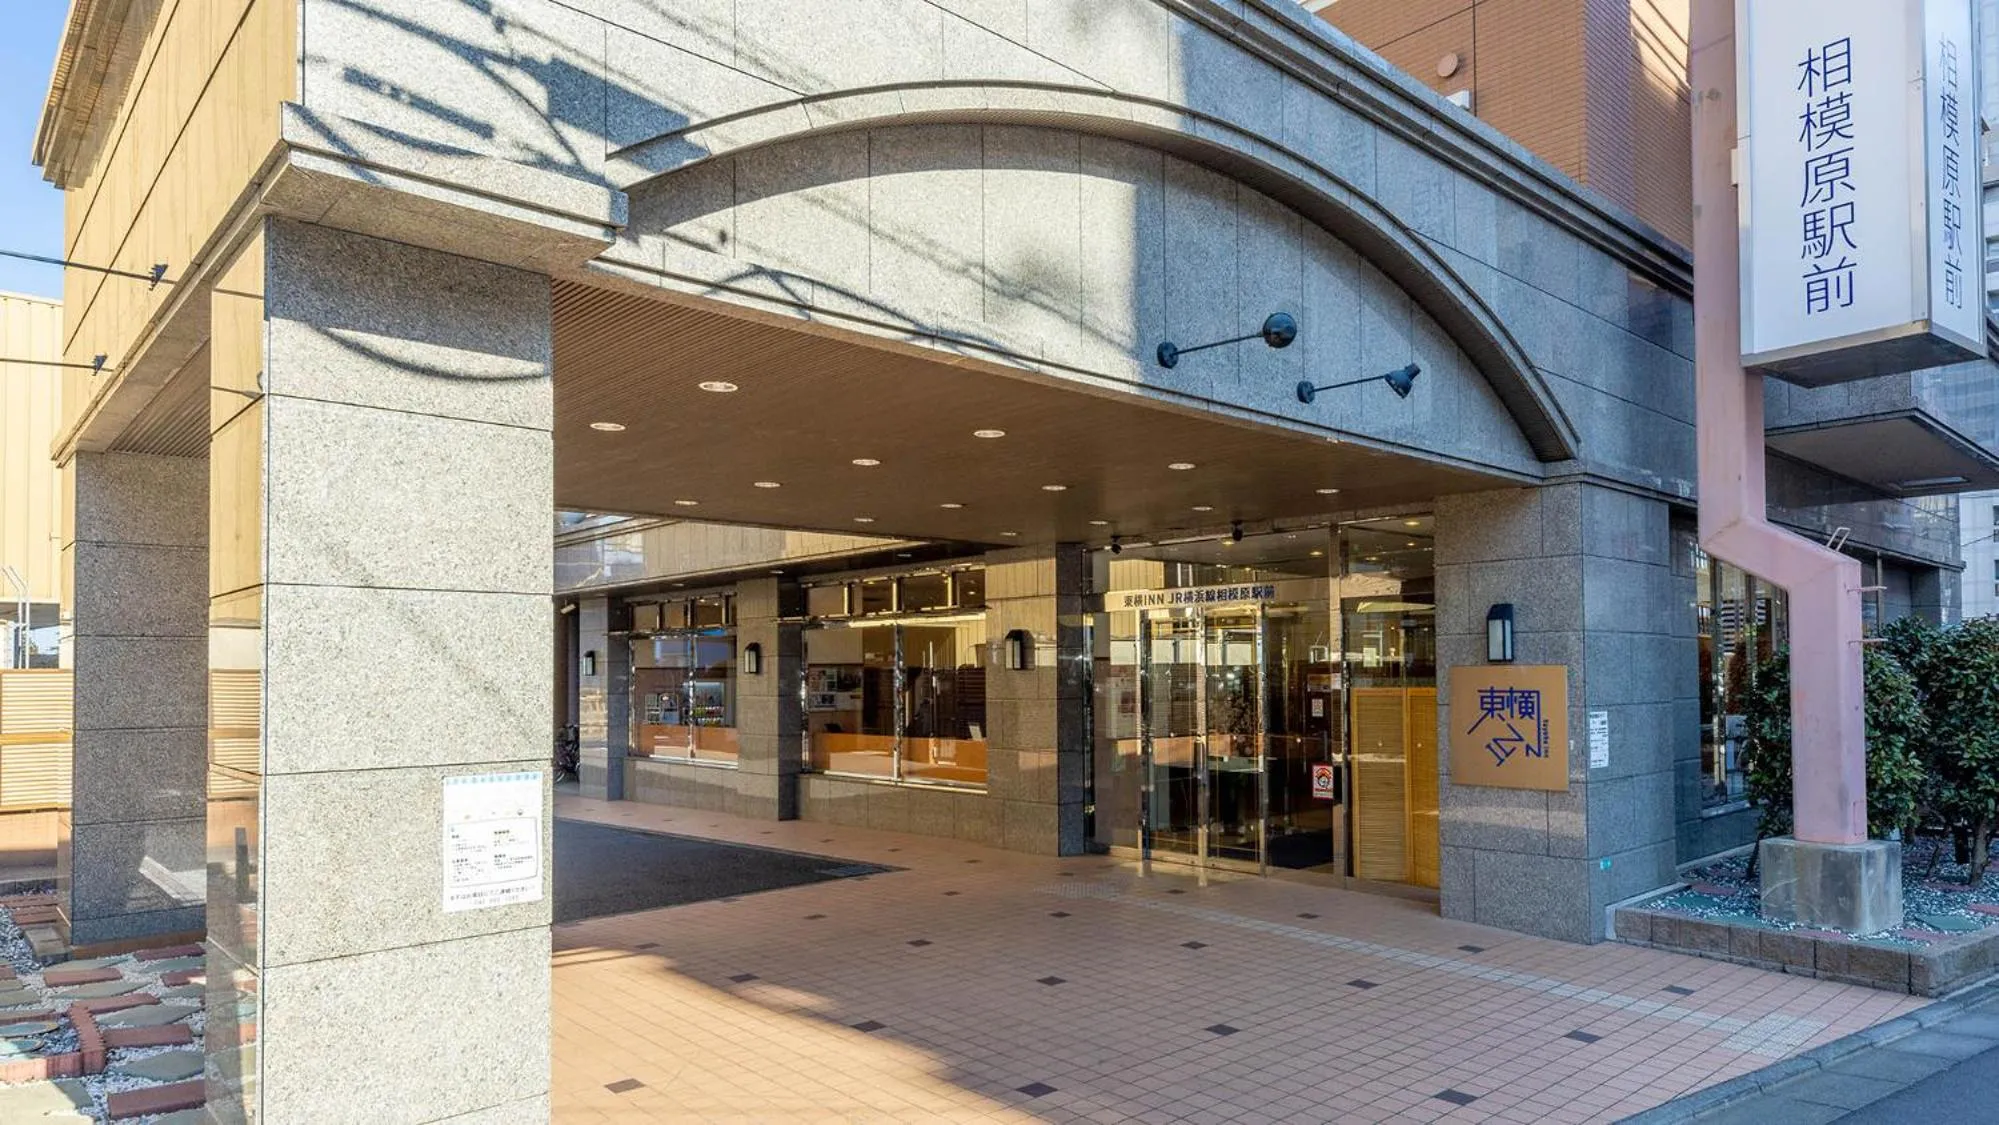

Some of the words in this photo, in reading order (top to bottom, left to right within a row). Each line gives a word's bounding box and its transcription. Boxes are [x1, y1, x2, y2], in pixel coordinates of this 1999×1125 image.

[1797, 36, 1858, 316] 相模原駅前
[1939, 33, 1964, 310] 相模原駅前
[1123, 593, 1165, 608] 東横INN
[1168, 585, 1276, 605] JR横浜線相模原駅前
